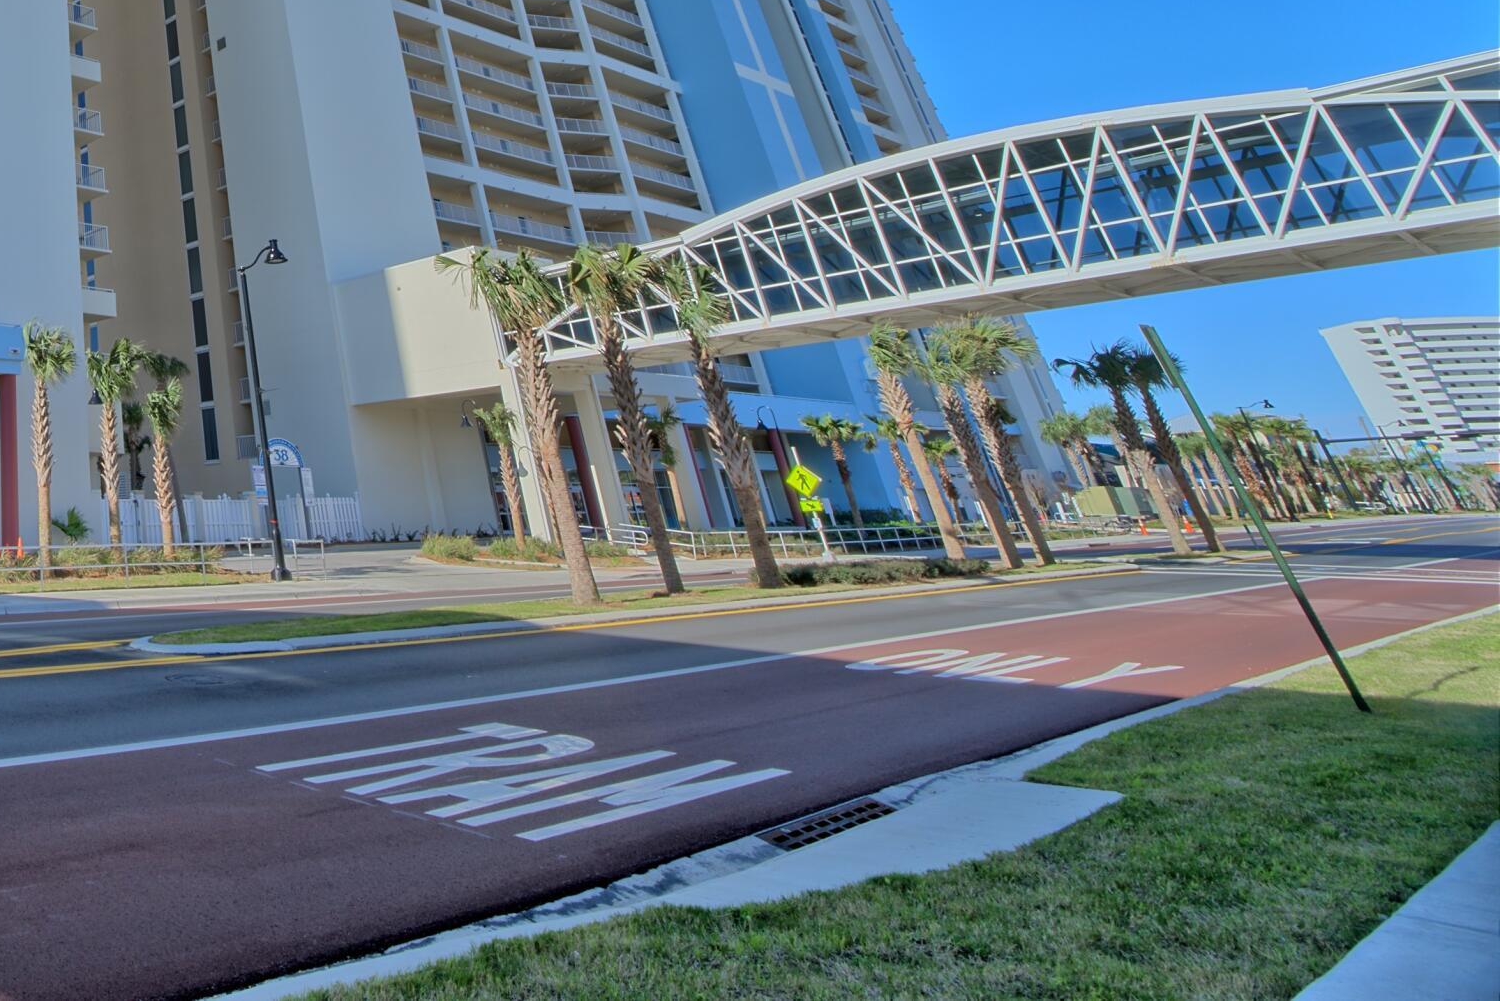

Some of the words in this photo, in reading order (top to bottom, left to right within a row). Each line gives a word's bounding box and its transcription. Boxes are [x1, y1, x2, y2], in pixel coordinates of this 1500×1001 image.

[274, 449, 288, 461] 38
[845, 649, 1184, 689] ONLY
[256, 722, 793, 842] TRAM
